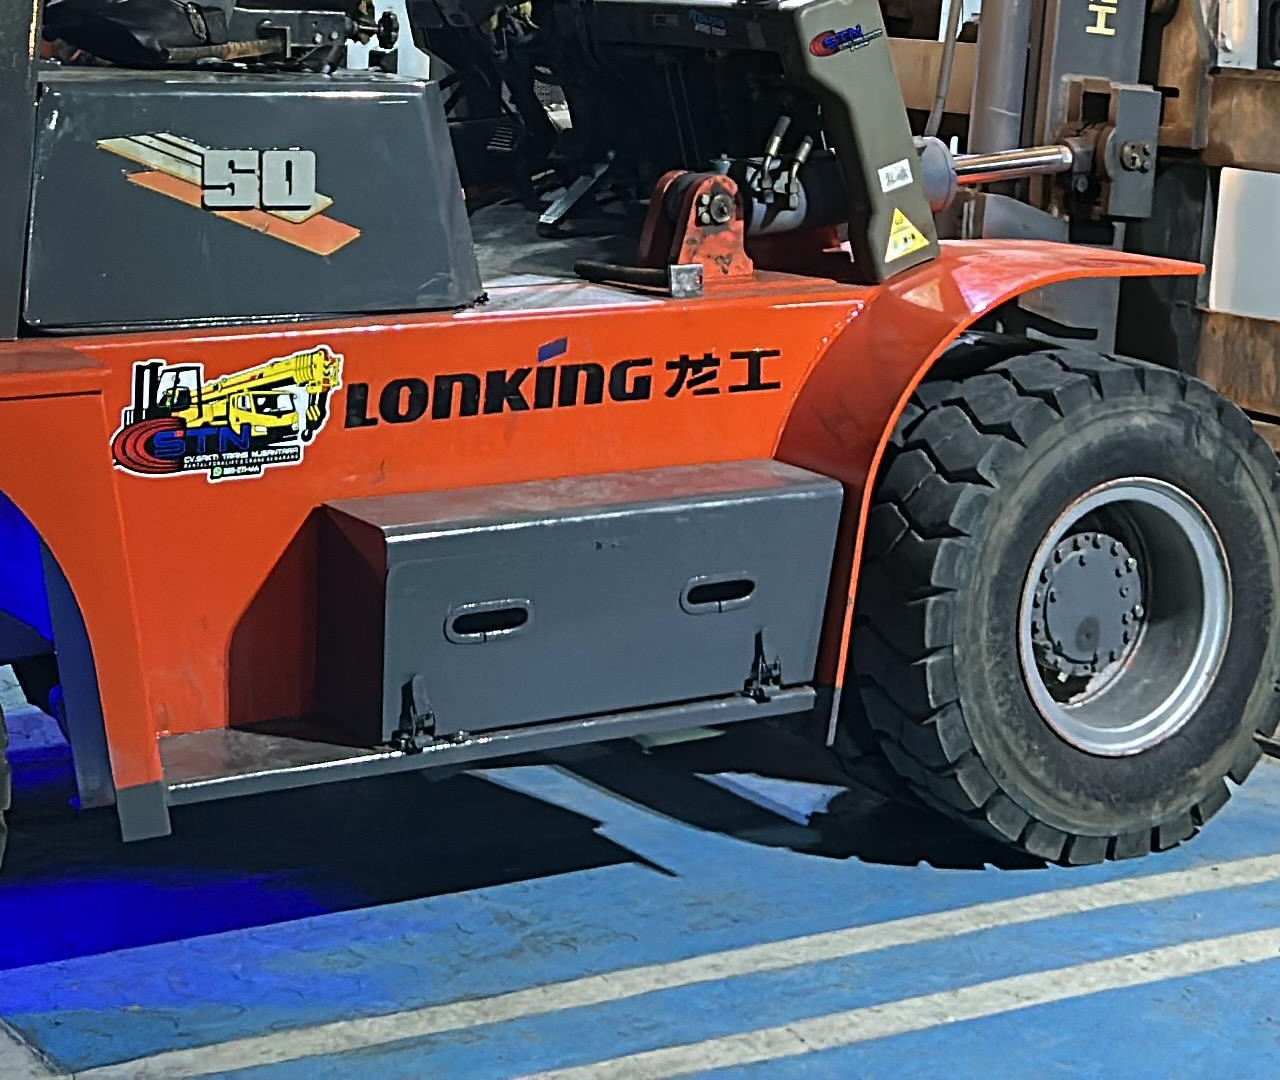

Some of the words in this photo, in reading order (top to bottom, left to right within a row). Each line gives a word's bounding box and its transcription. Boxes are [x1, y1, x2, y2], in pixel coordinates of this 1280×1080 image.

[202, 149, 316, 210] 50
[343, 336, 653, 428] LONKING
[665, 348, 781, 398] 龙工
[153, 426, 252, 459] STN
